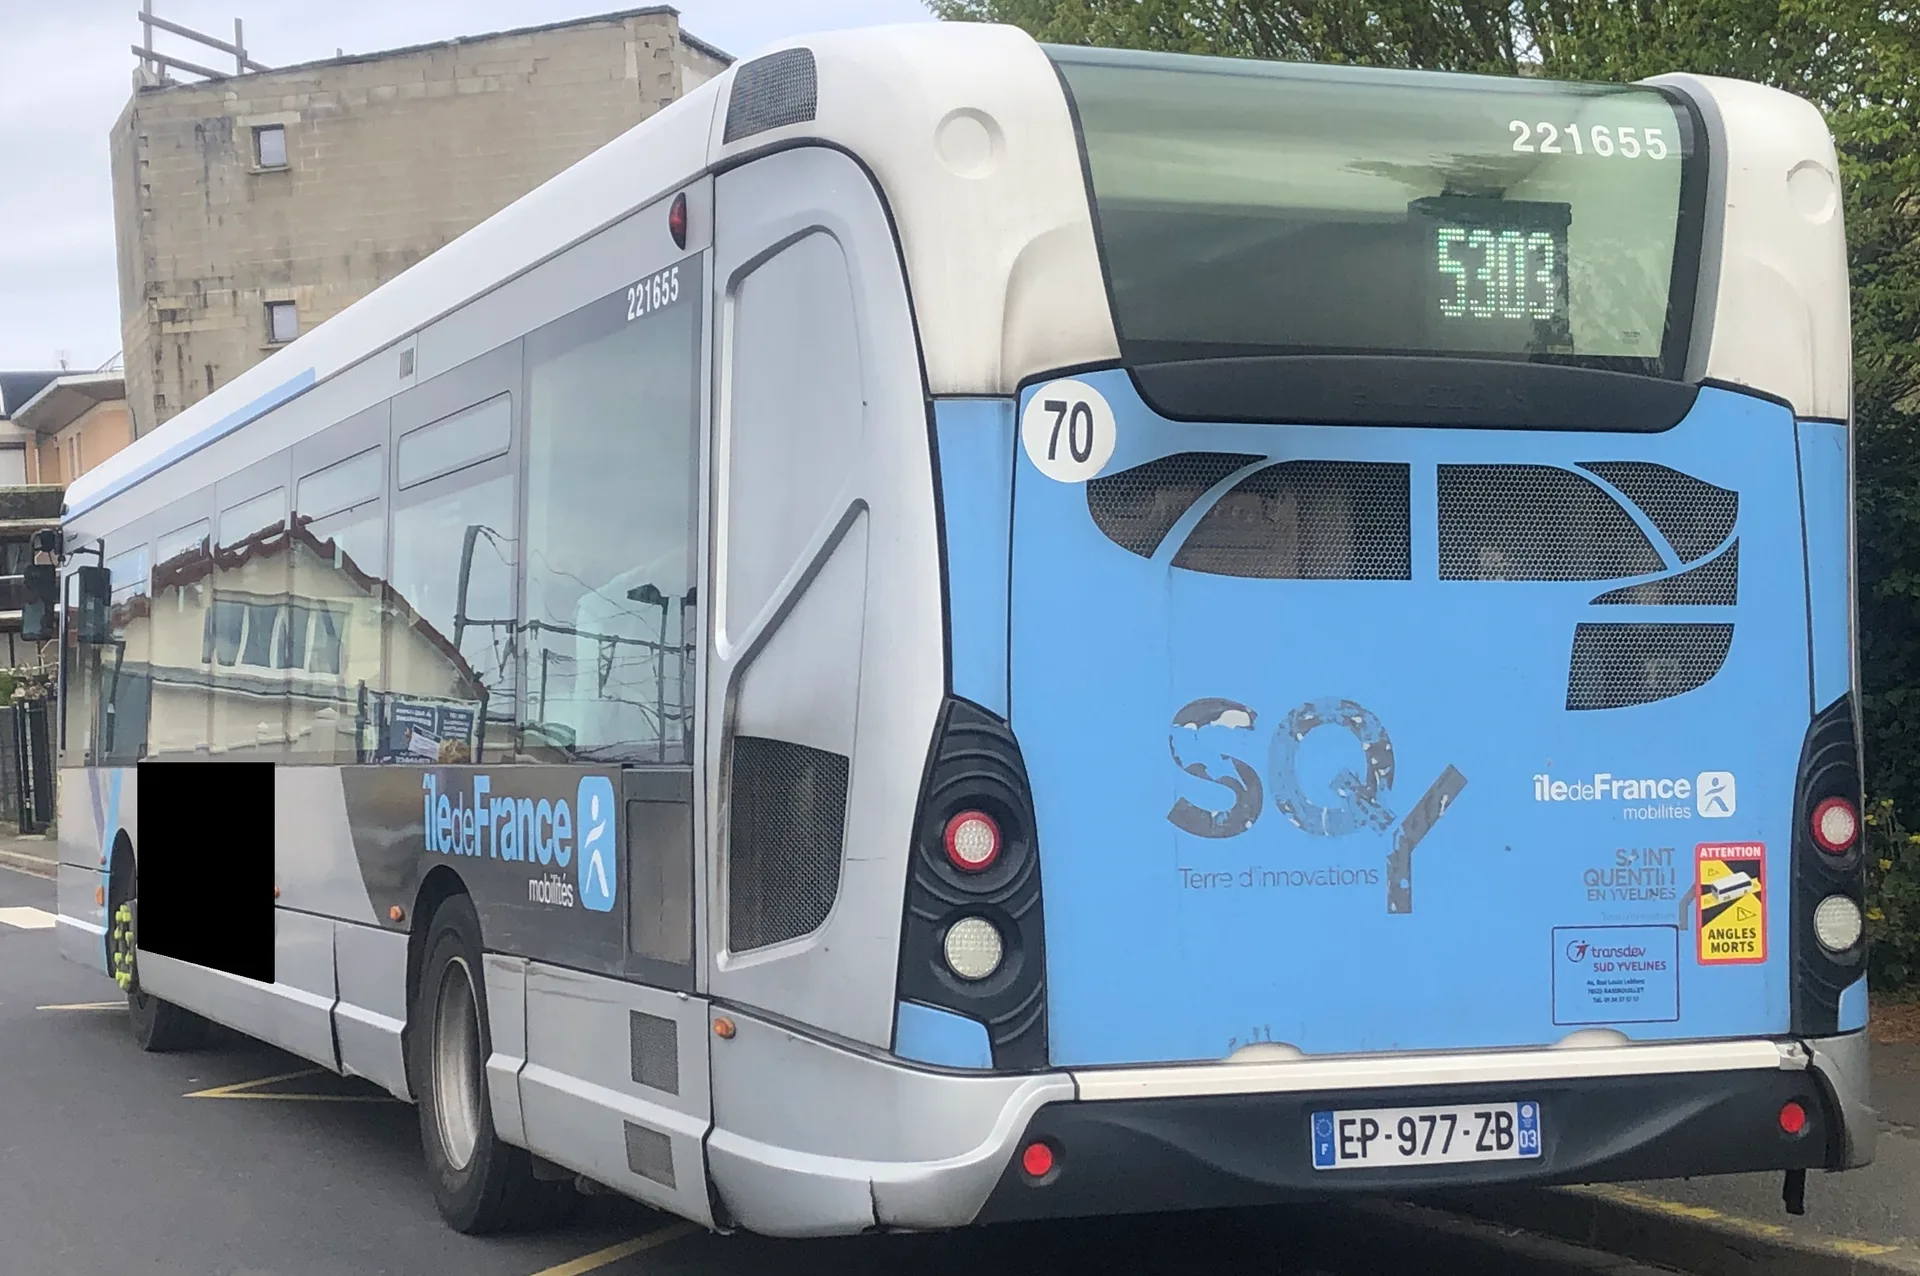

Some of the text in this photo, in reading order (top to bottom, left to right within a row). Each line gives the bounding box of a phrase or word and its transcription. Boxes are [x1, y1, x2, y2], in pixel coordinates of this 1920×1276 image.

[1509, 120, 1667, 160] 221655
[1439, 228, 1554, 319] 5303
[627, 266, 679, 321] 221655
[1044, 400, 1094, 463] 70
[1623, 804, 1692, 821] mobilités
[1700, 846, 1761, 858] ATTENTION
[1178, 868, 1233, 889] Terre
[528, 873, 574, 908] mobilités
[1587, 888, 1604, 901] EN
[1707, 927, 1757, 941] ANGLES
[1590, 945, 1647, 958] transdev
[1710, 941, 1755, 954] MORTS
[1593, 960, 1667, 972] SUD YVELINES
[1338, 1111, 1515, 1160] EP-977-ZB
[1519, 1129, 1538, 1148] 03
[1321, 1143, 1329, 1156] F
